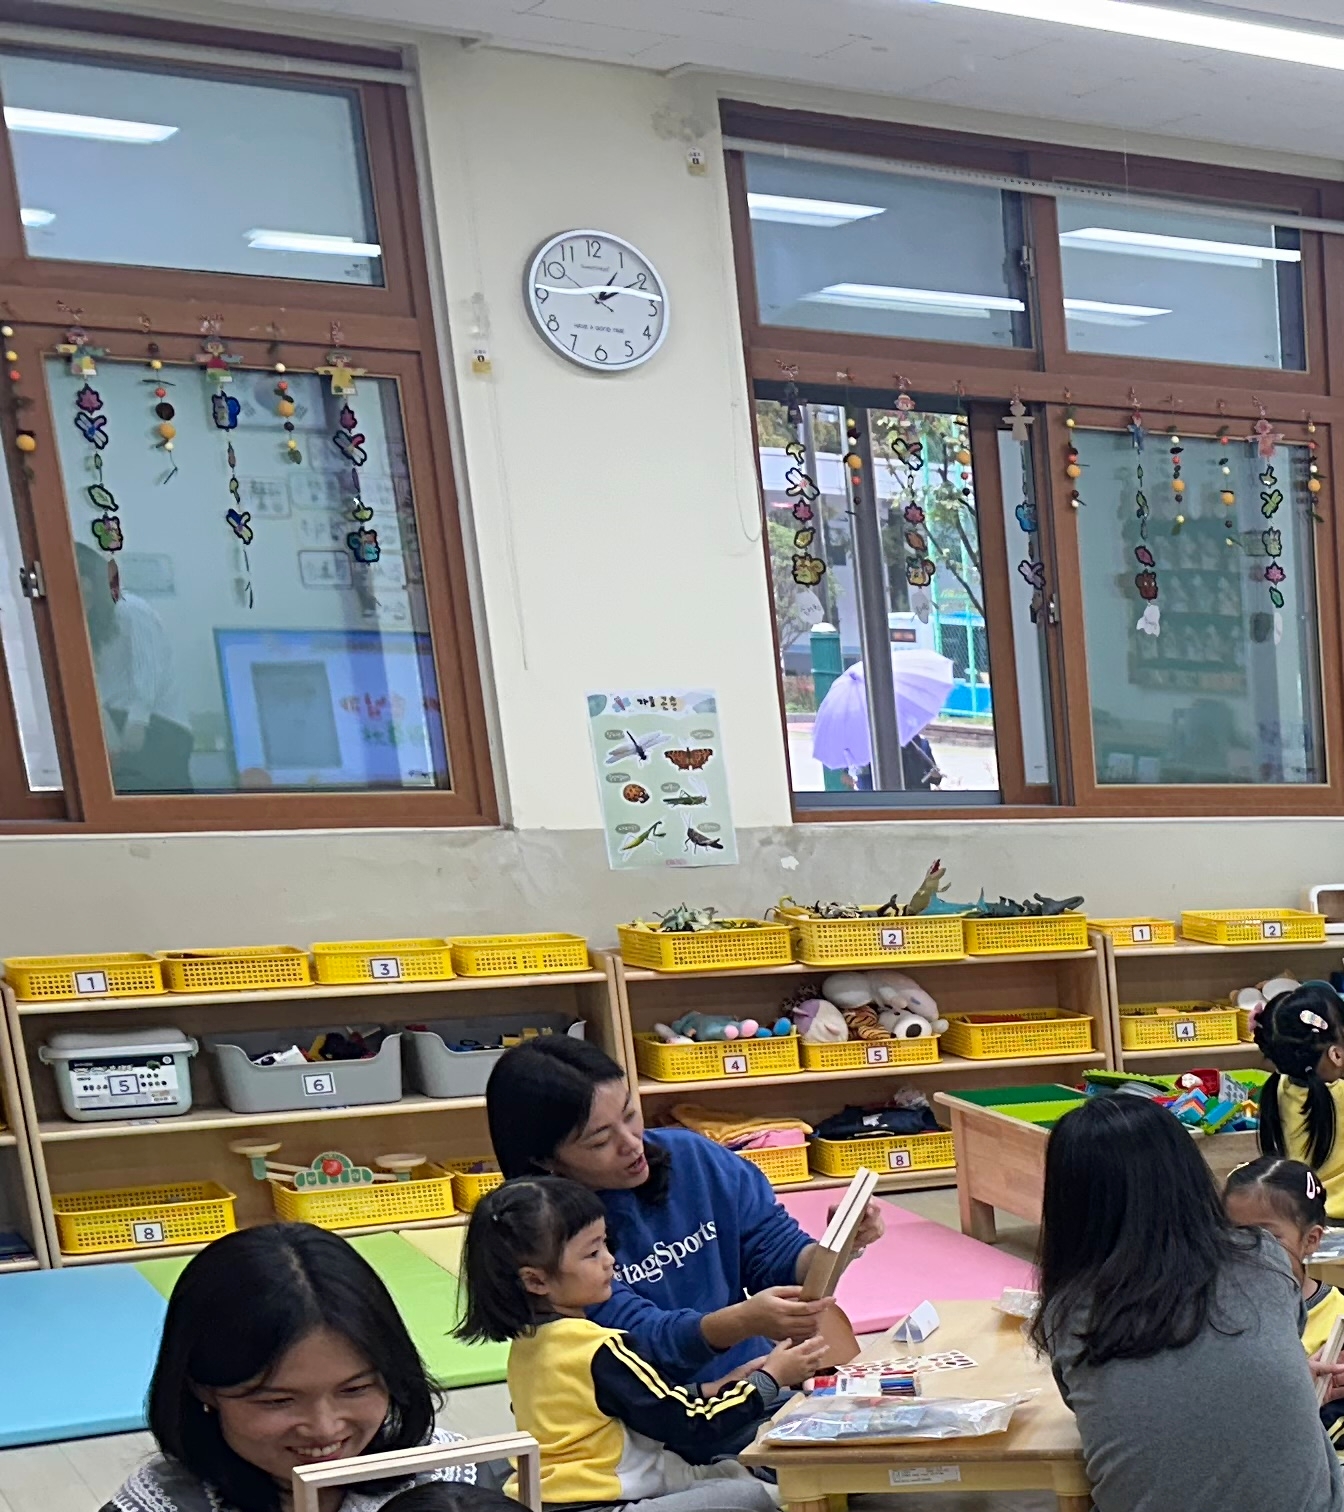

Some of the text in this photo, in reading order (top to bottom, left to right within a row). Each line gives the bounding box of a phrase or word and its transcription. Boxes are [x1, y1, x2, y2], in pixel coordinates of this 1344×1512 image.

[560, 244, 574, 263] 11
[586, 240, 602, 258] 12
[619, 252, 624, 268] 1
[542, 261, 565, 279] 10
[637, 273, 648, 290] 2
[535, 287, 549, 304] 9
[648, 299, 658, 317] 3
[547, 314, 560, 332] 8
[643, 325, 652, 340] 4
[570, 334, 578, 352] 7
[624, 340, 634, 358] 5
[595, 344, 608, 361] 6
[1138, 929, 1145, 939] 1
[1268, 925, 1277, 935] 2
[888, 933, 897, 945] 2
[380, 963, 390, 975] 3
[88, 977, 95, 989] 1
[1181, 1026, 1190, 1036] 4
[873, 1050, 882, 1061] 5
[731, 1060, 740, 1071] 4
[119, 1080, 130, 1092] 5
[314, 1079, 324, 1091] 6
[895, 1155, 904, 1166] 8
[144, 1228, 154, 1240] 8
